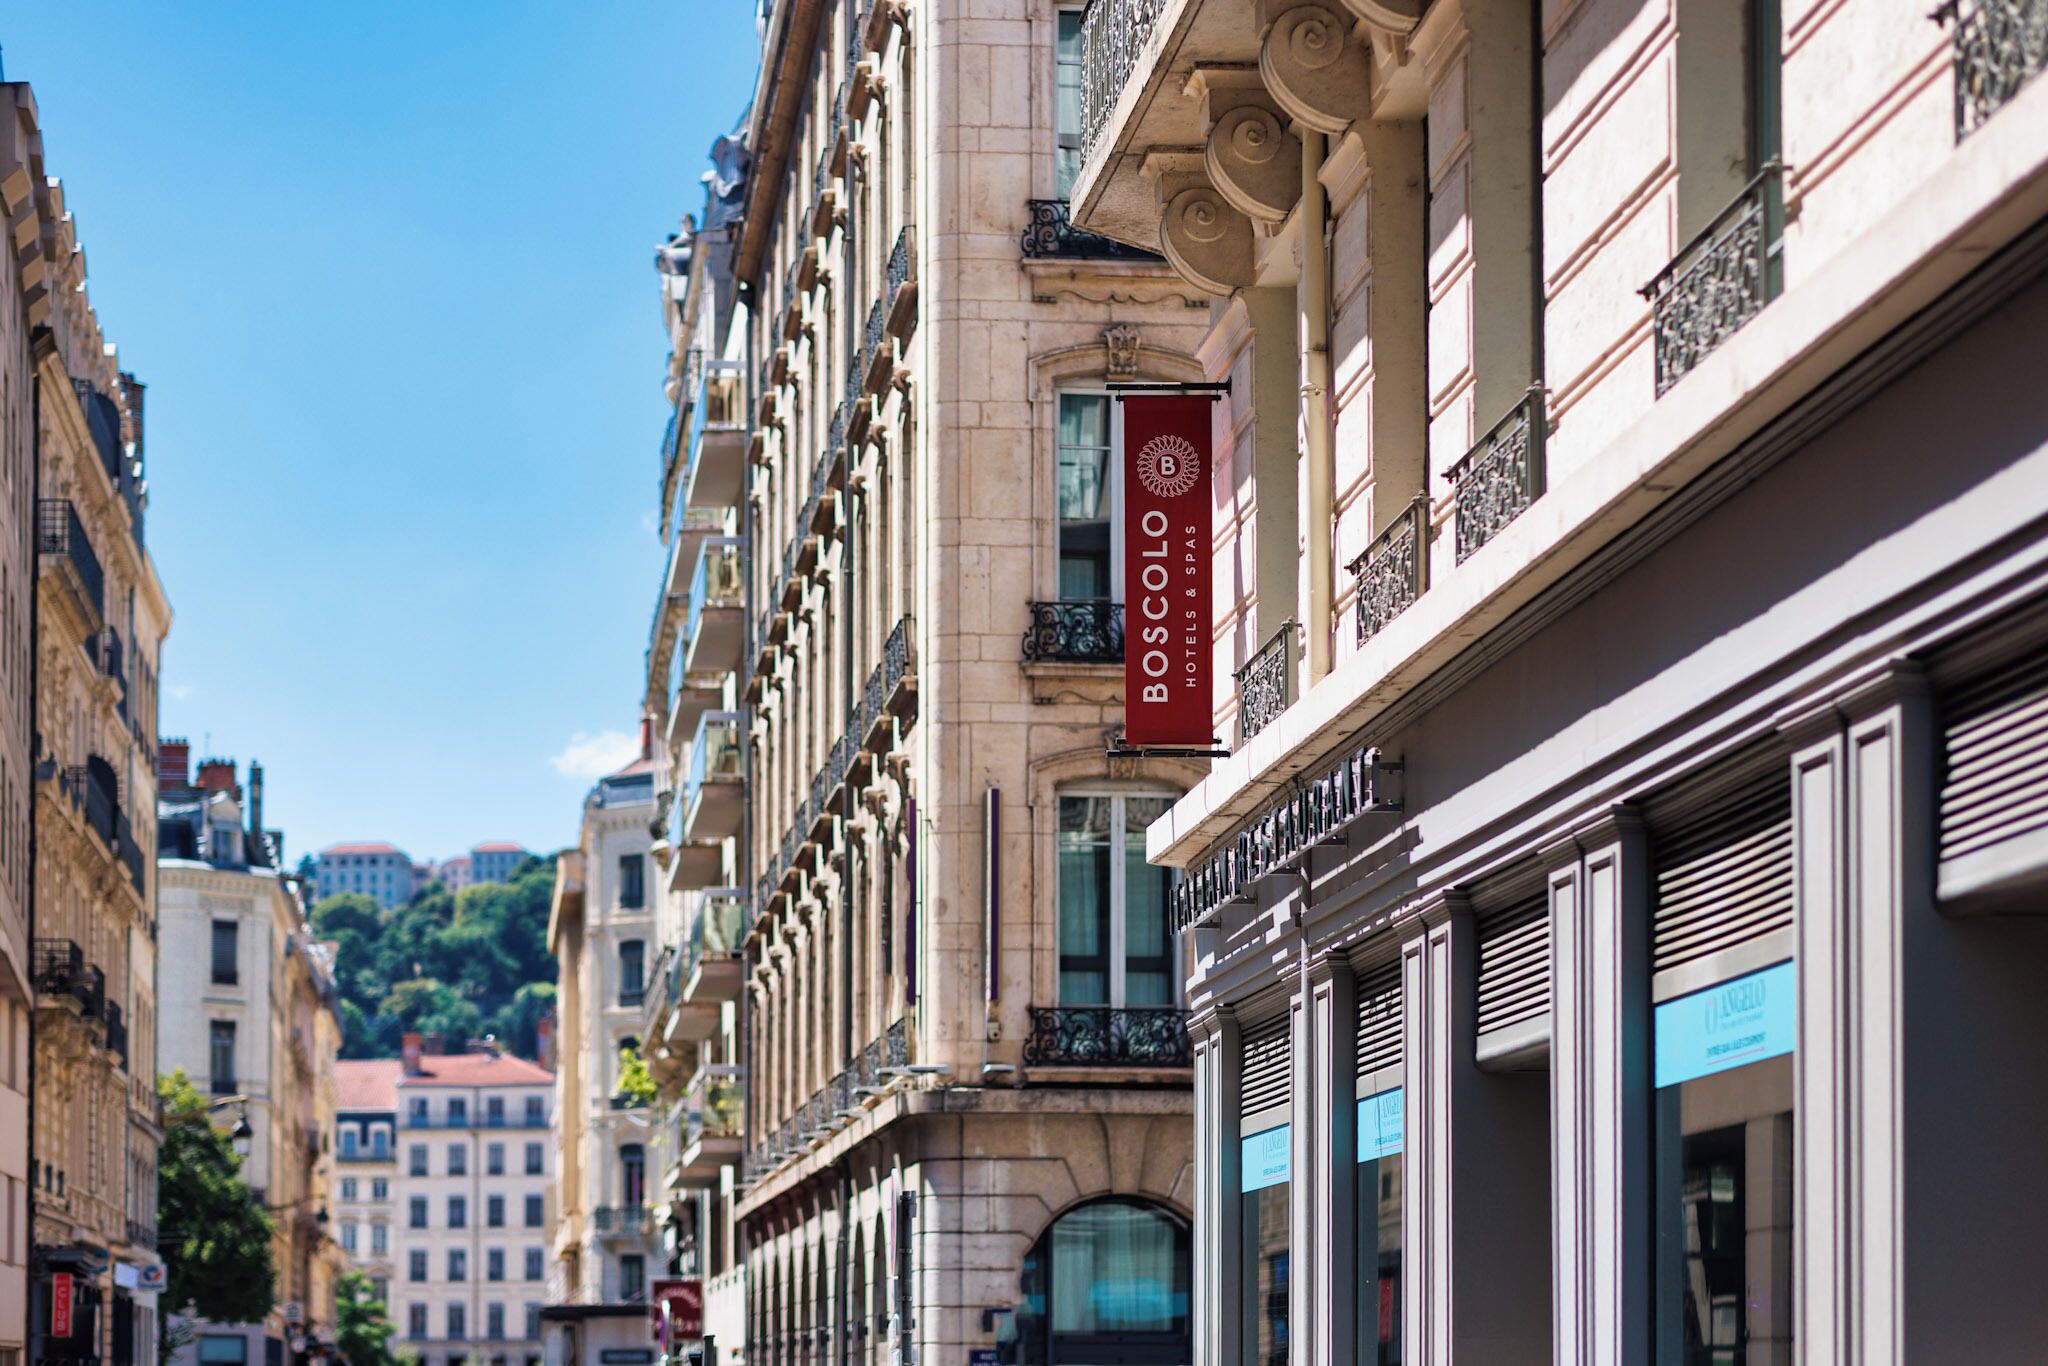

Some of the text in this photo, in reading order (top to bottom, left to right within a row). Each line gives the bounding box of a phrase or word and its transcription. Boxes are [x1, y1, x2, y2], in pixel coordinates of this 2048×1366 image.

[1160, 455, 1176, 476] B
[1142, 510, 1169, 703] BOSCOLO
[1185, 525, 1197, 688] HOTELS & SPAS
[1237, 746, 1374, 885] RESTAURANT
[1720, 978, 1766, 1018] ANGELO
